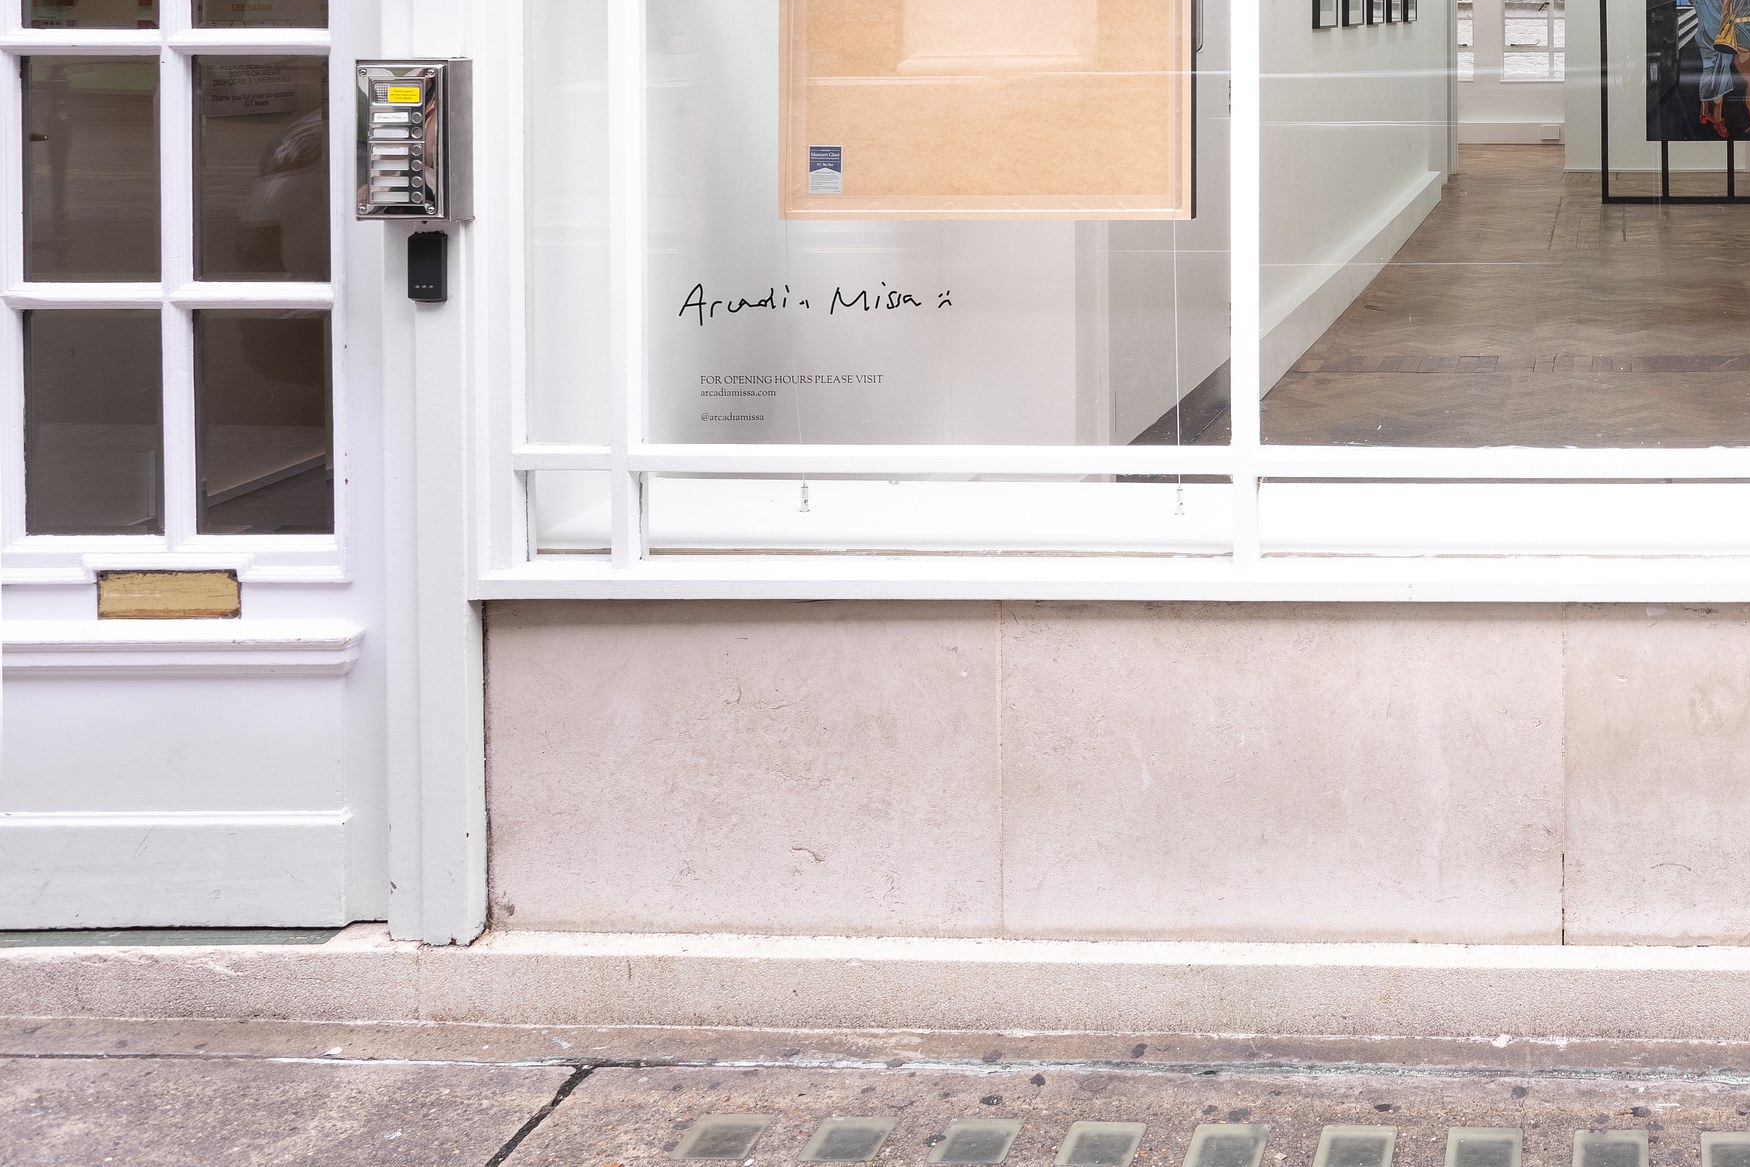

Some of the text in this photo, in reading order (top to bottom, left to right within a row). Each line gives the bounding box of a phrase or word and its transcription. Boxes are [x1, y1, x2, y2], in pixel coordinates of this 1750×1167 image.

[212, 94, 230, 102] Thank
[679, 281, 922, 326] Arcadia Missa
[700, 374, 883, 385] FOR OPENING HOURS PLEASE VISIT
[700, 387, 776, 397] arcadiamissa.com
[700, 411, 764, 422] @arcadiamissa
